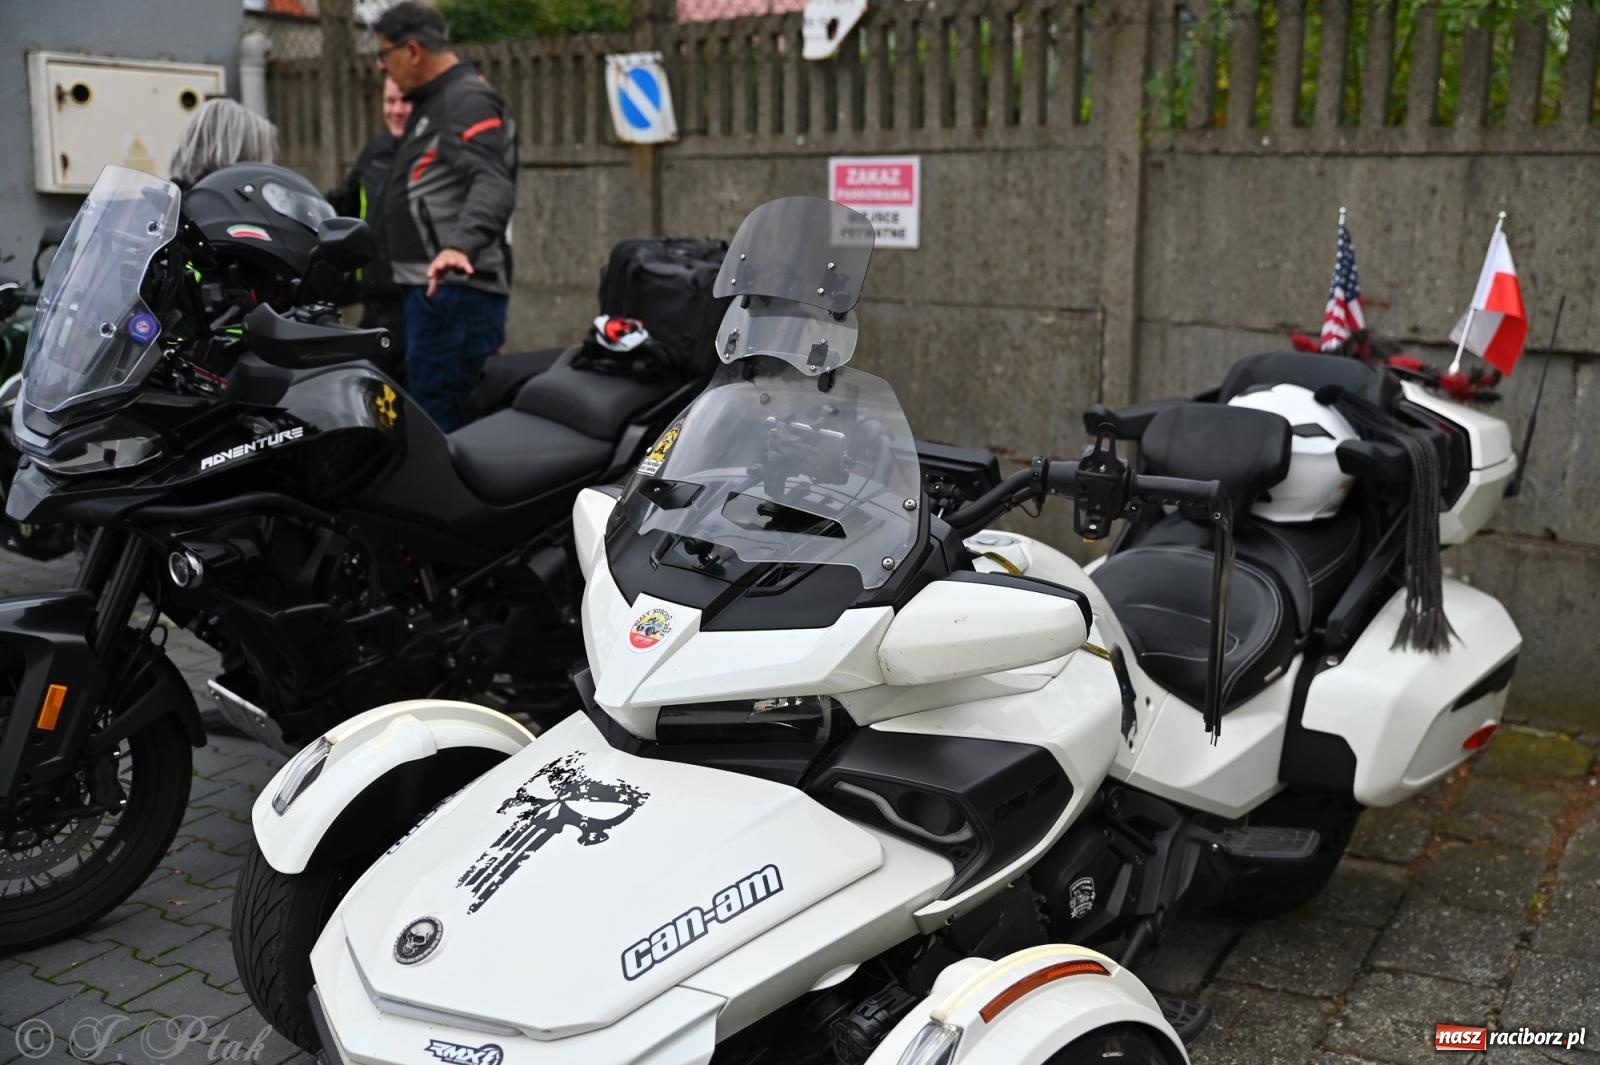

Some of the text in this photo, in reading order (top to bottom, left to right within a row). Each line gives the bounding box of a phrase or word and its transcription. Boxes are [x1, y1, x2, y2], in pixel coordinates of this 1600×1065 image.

[846, 167, 901, 185] ZAKAZ
[201, 426, 304, 471] ADVENTURE
[622, 864, 784, 981] can-am
